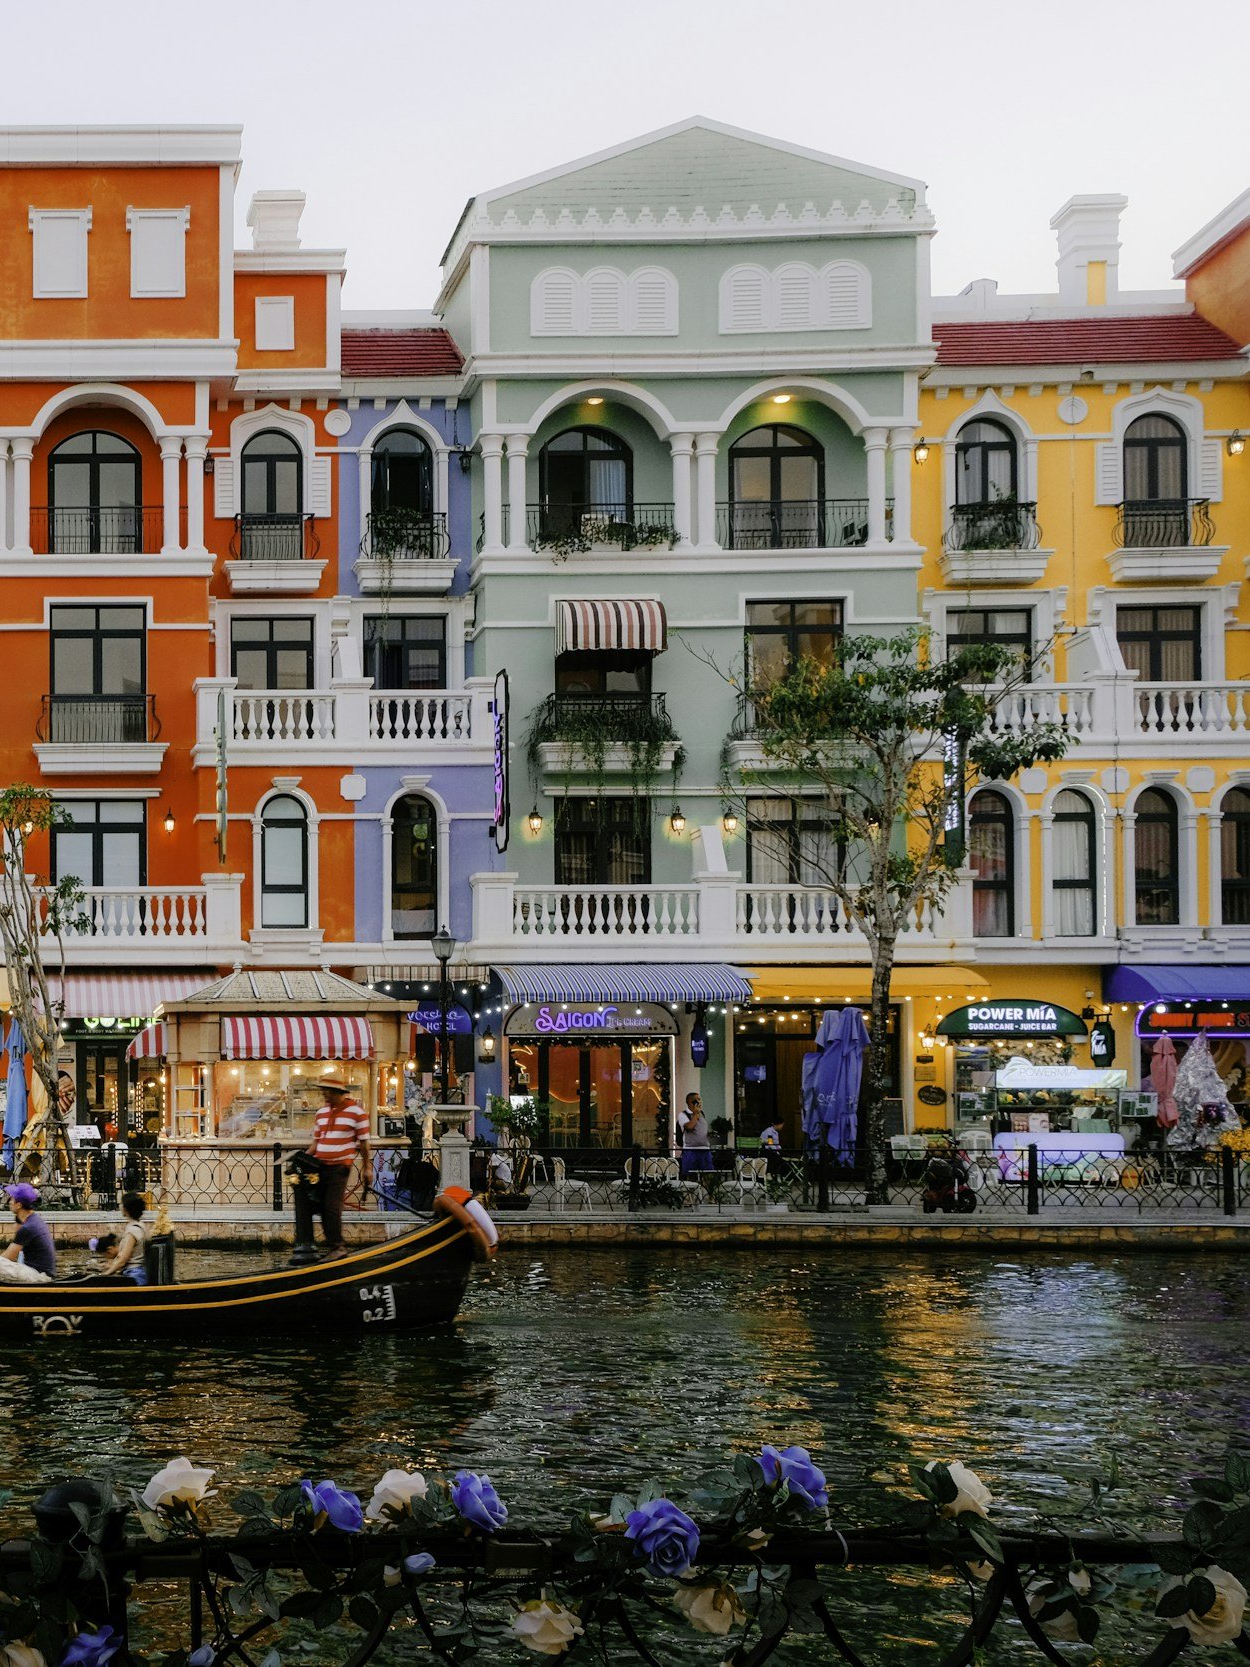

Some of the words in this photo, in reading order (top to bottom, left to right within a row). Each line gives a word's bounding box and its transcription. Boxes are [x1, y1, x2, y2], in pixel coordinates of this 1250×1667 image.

[535, 1007, 618, 1032] SAIGON
[968, 1008, 1024, 1020] POWER
[968, 1023, 1015, 1031] SUGARCANE
[1019, 1023, 1041, 1031] JUICE
[1041, 1023, 1057, 1031] BAR
[359, 1286, 381, 1301] 0.4
[32, 1316, 44, 1327] R
[70, 1315, 83, 1327] V
[363, 1308, 384, 1322] 0.2
